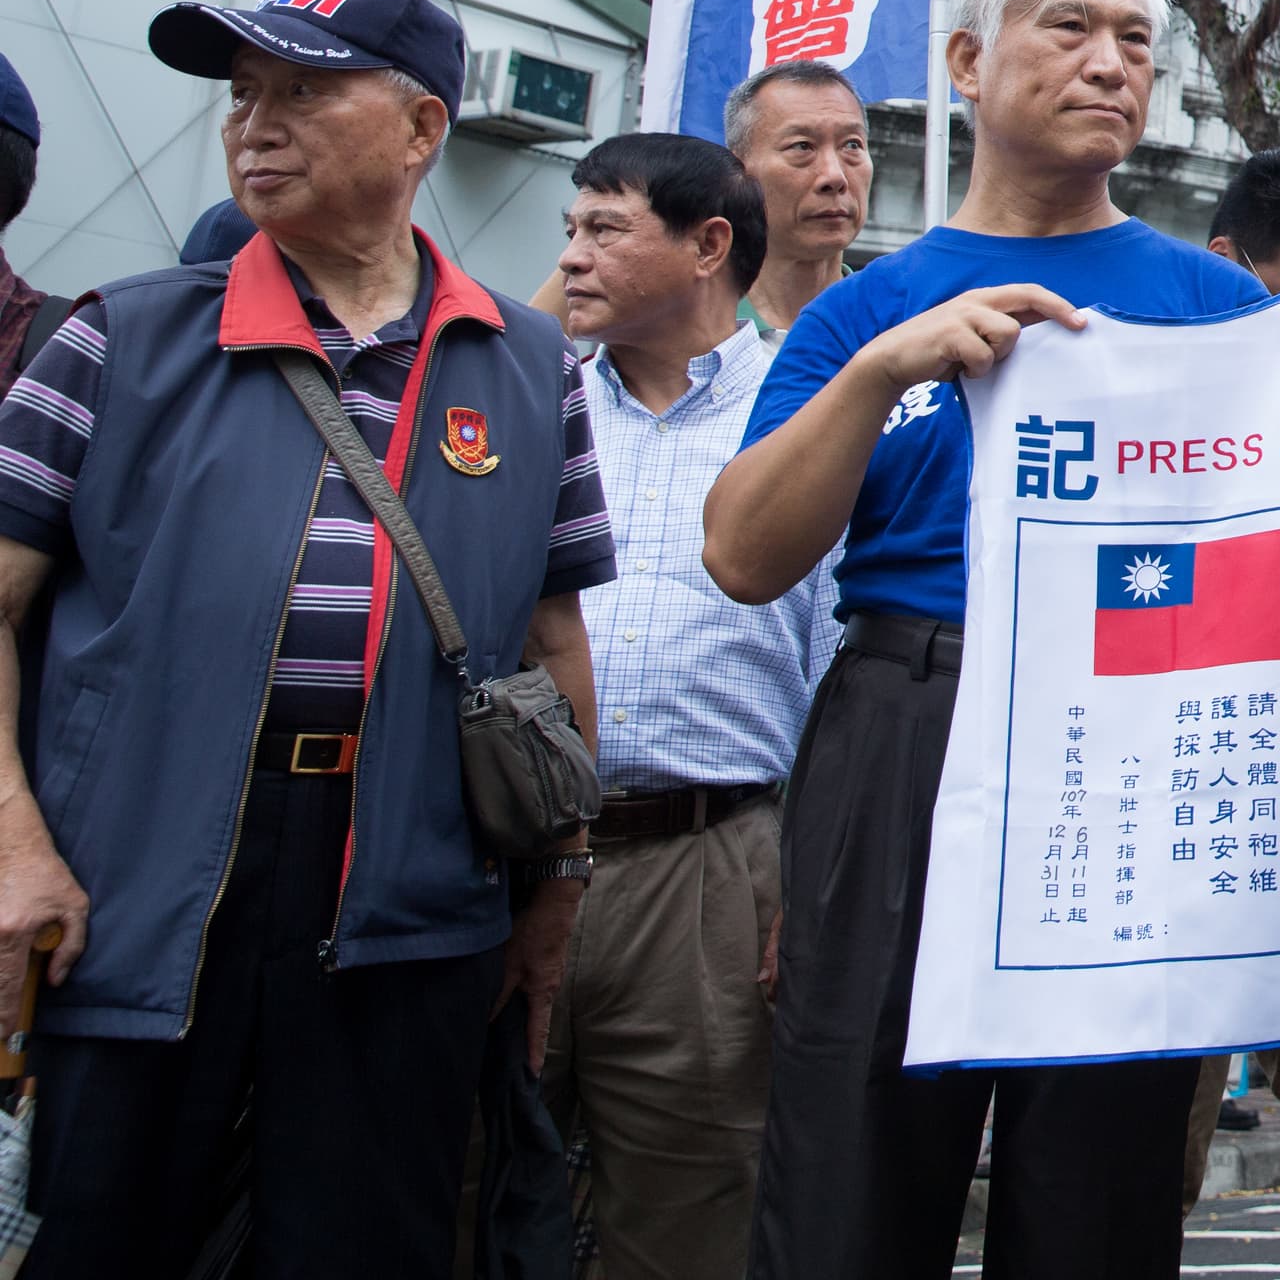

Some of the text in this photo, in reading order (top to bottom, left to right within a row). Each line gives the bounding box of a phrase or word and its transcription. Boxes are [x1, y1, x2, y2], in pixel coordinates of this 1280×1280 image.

[1015, 414, 1098, 500] 記
[1116, 433, 1263, 476] PRESS
[1115, 755, 1142, 905] 八百壯士指揮部
[1171, 700, 1203, 861] 與採訪自由
[1208, 694, 1239, 894] 護其人身安全
[1247, 692, 1279, 892] 請全體同袍維
